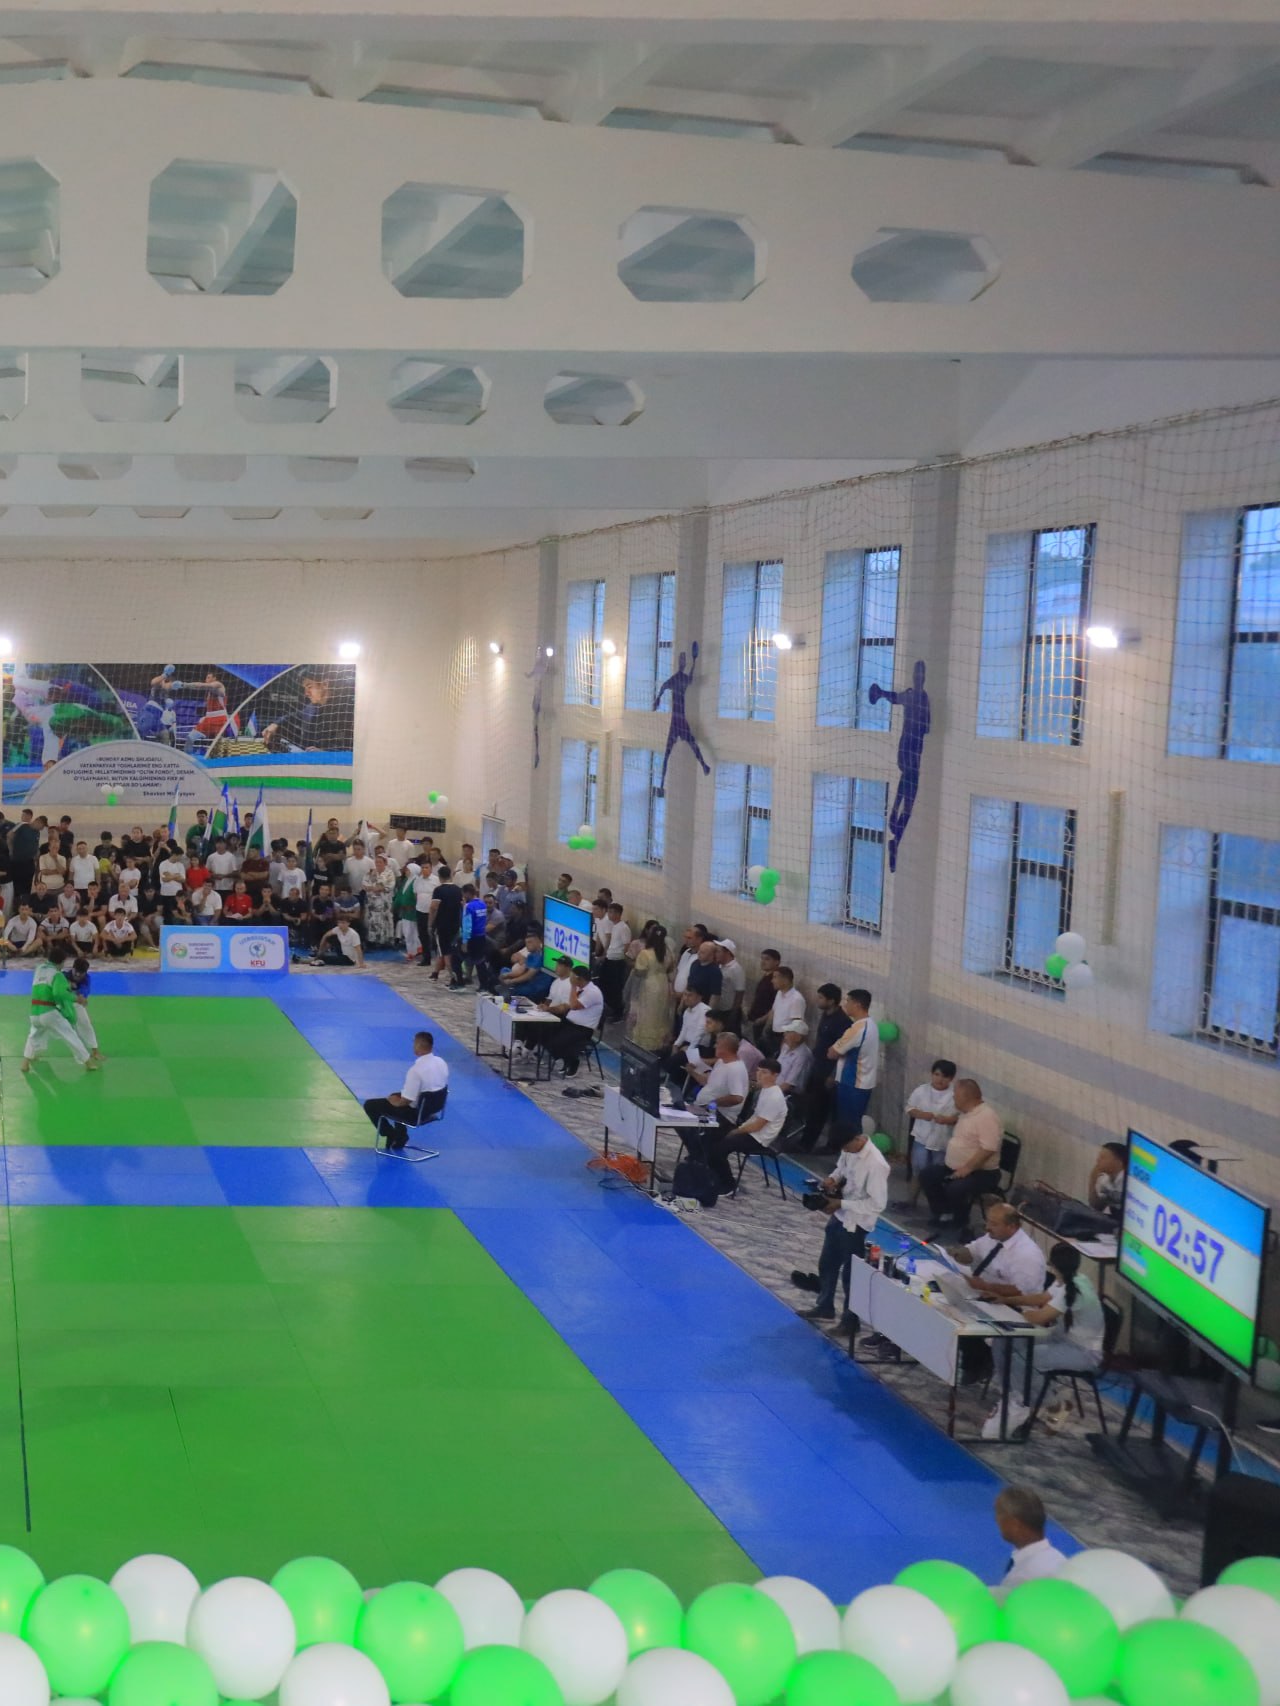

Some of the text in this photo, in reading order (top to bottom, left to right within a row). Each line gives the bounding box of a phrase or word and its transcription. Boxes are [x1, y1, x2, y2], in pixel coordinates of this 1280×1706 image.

[554, 927, 580, 957] 02:17
[250, 959, 266, 967] KFU
[1152, 1203, 1225, 1284] 02:57
